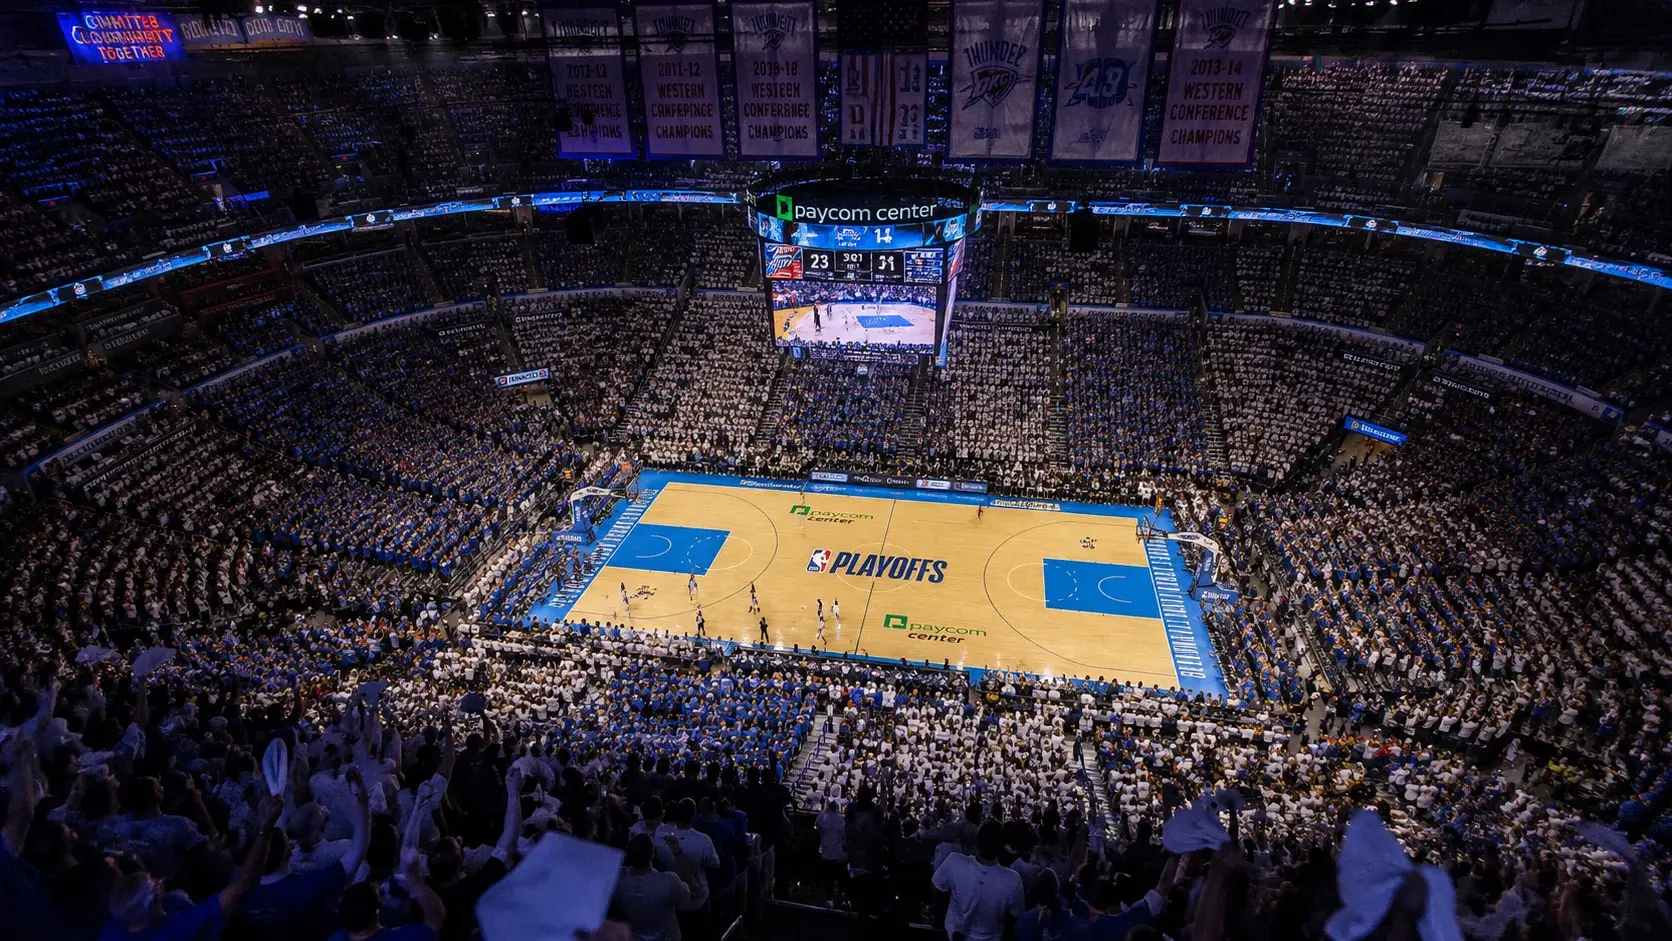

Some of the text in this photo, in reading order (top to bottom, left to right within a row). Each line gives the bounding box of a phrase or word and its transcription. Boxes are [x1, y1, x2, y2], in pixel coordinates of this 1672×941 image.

[98, 45, 165, 60] TOGETHER
[1190, 58, 1243, 76] 2013-14
[1183, 82, 1245, 101] WESTERN
[1169, 103, 1250, 121] CONFERENCE
[655, 124, 714, 139] CHAMPIONS
[1170, 128, 1242, 145] CHAMPIONS
[795, 203, 937, 223] paycom center
[810, 253, 829, 269] 23
[810, 510, 874, 520] paycom
[829, 551, 948, 584] PLAYOFFS
[908, 632, 966, 644] center
[909, 623, 987, 637] paycom
